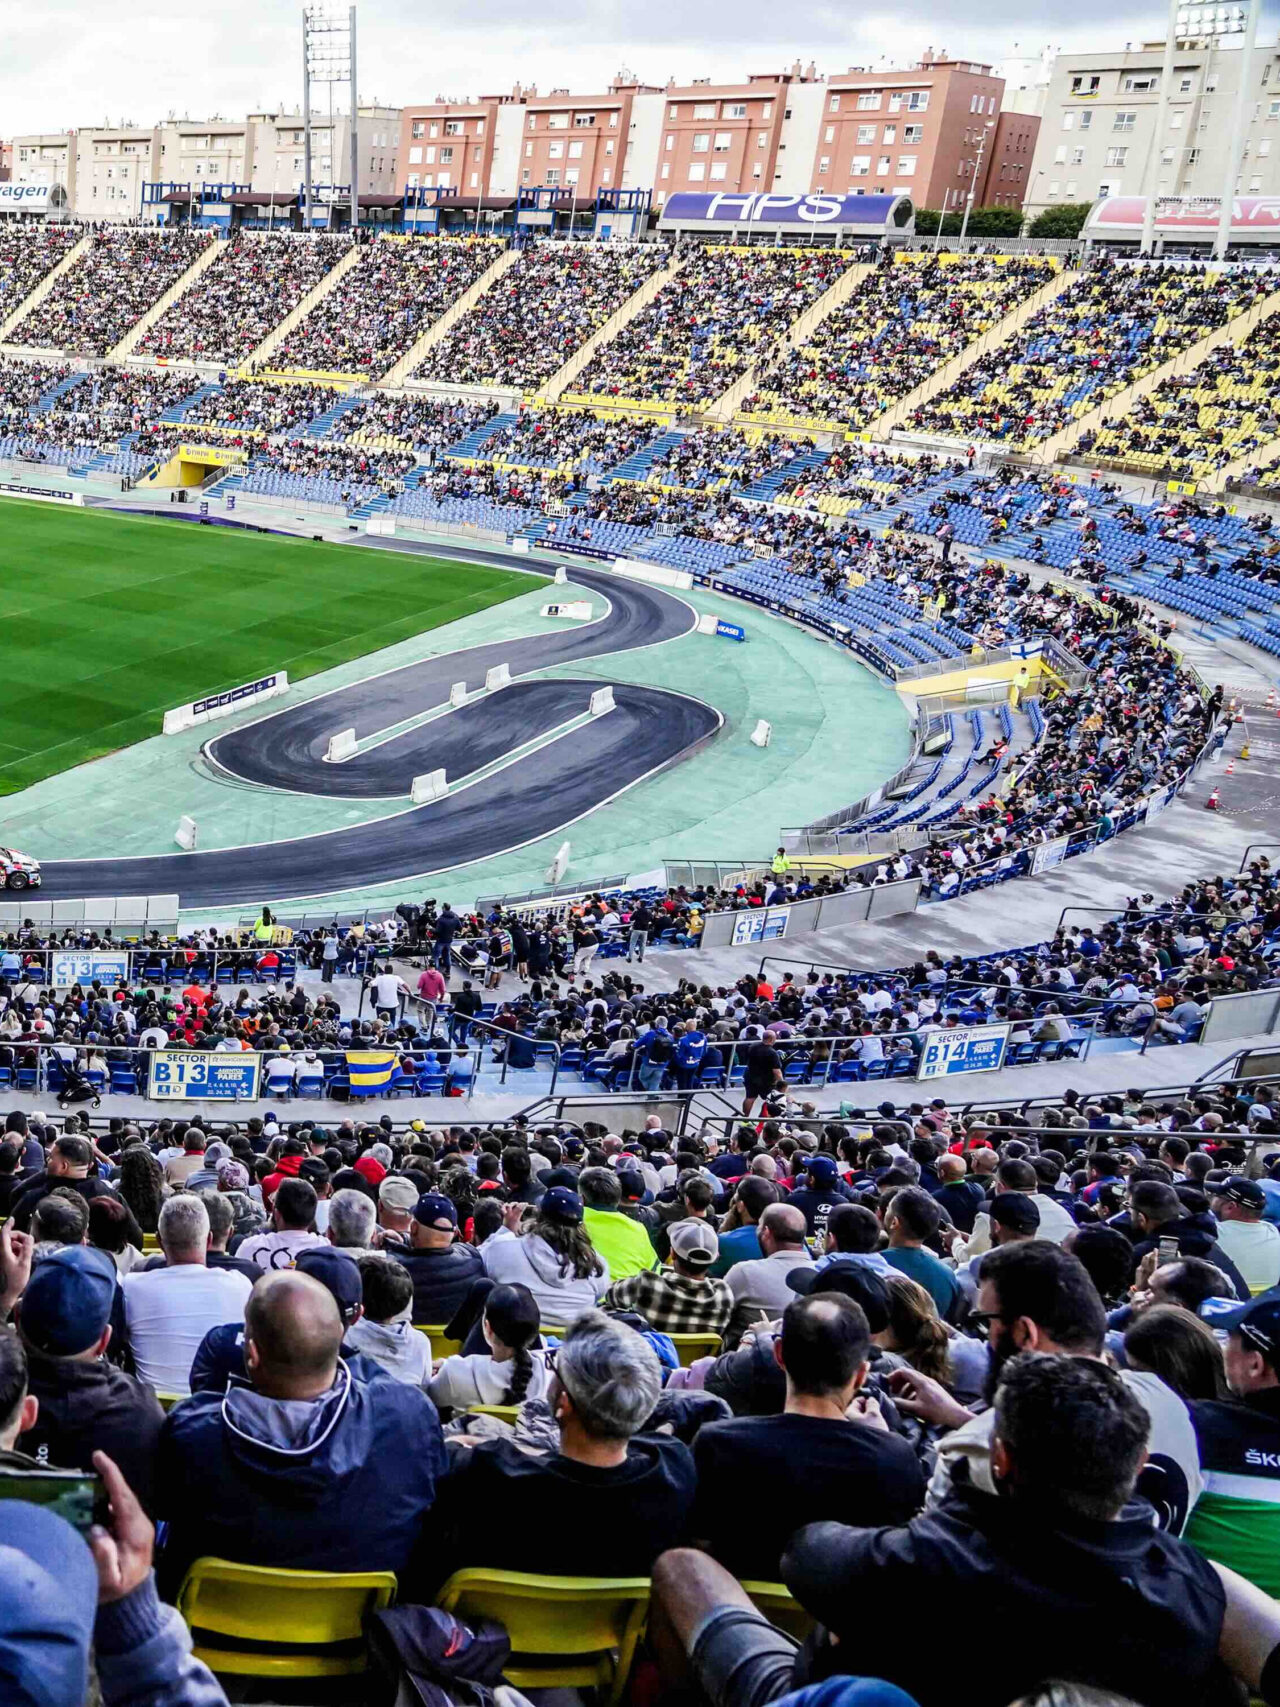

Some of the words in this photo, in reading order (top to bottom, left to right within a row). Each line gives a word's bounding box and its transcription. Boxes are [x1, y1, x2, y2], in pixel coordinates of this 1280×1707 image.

[706, 192, 846, 221] HPS
[737, 920, 763, 933] C15
[56, 962, 91, 976] C13
[938, 1032, 968, 1043] SECTOR
[167, 1054, 206, 1063] SECTOR
[925, 1042, 965, 1063] B14
[155, 1063, 207, 1083] B13
